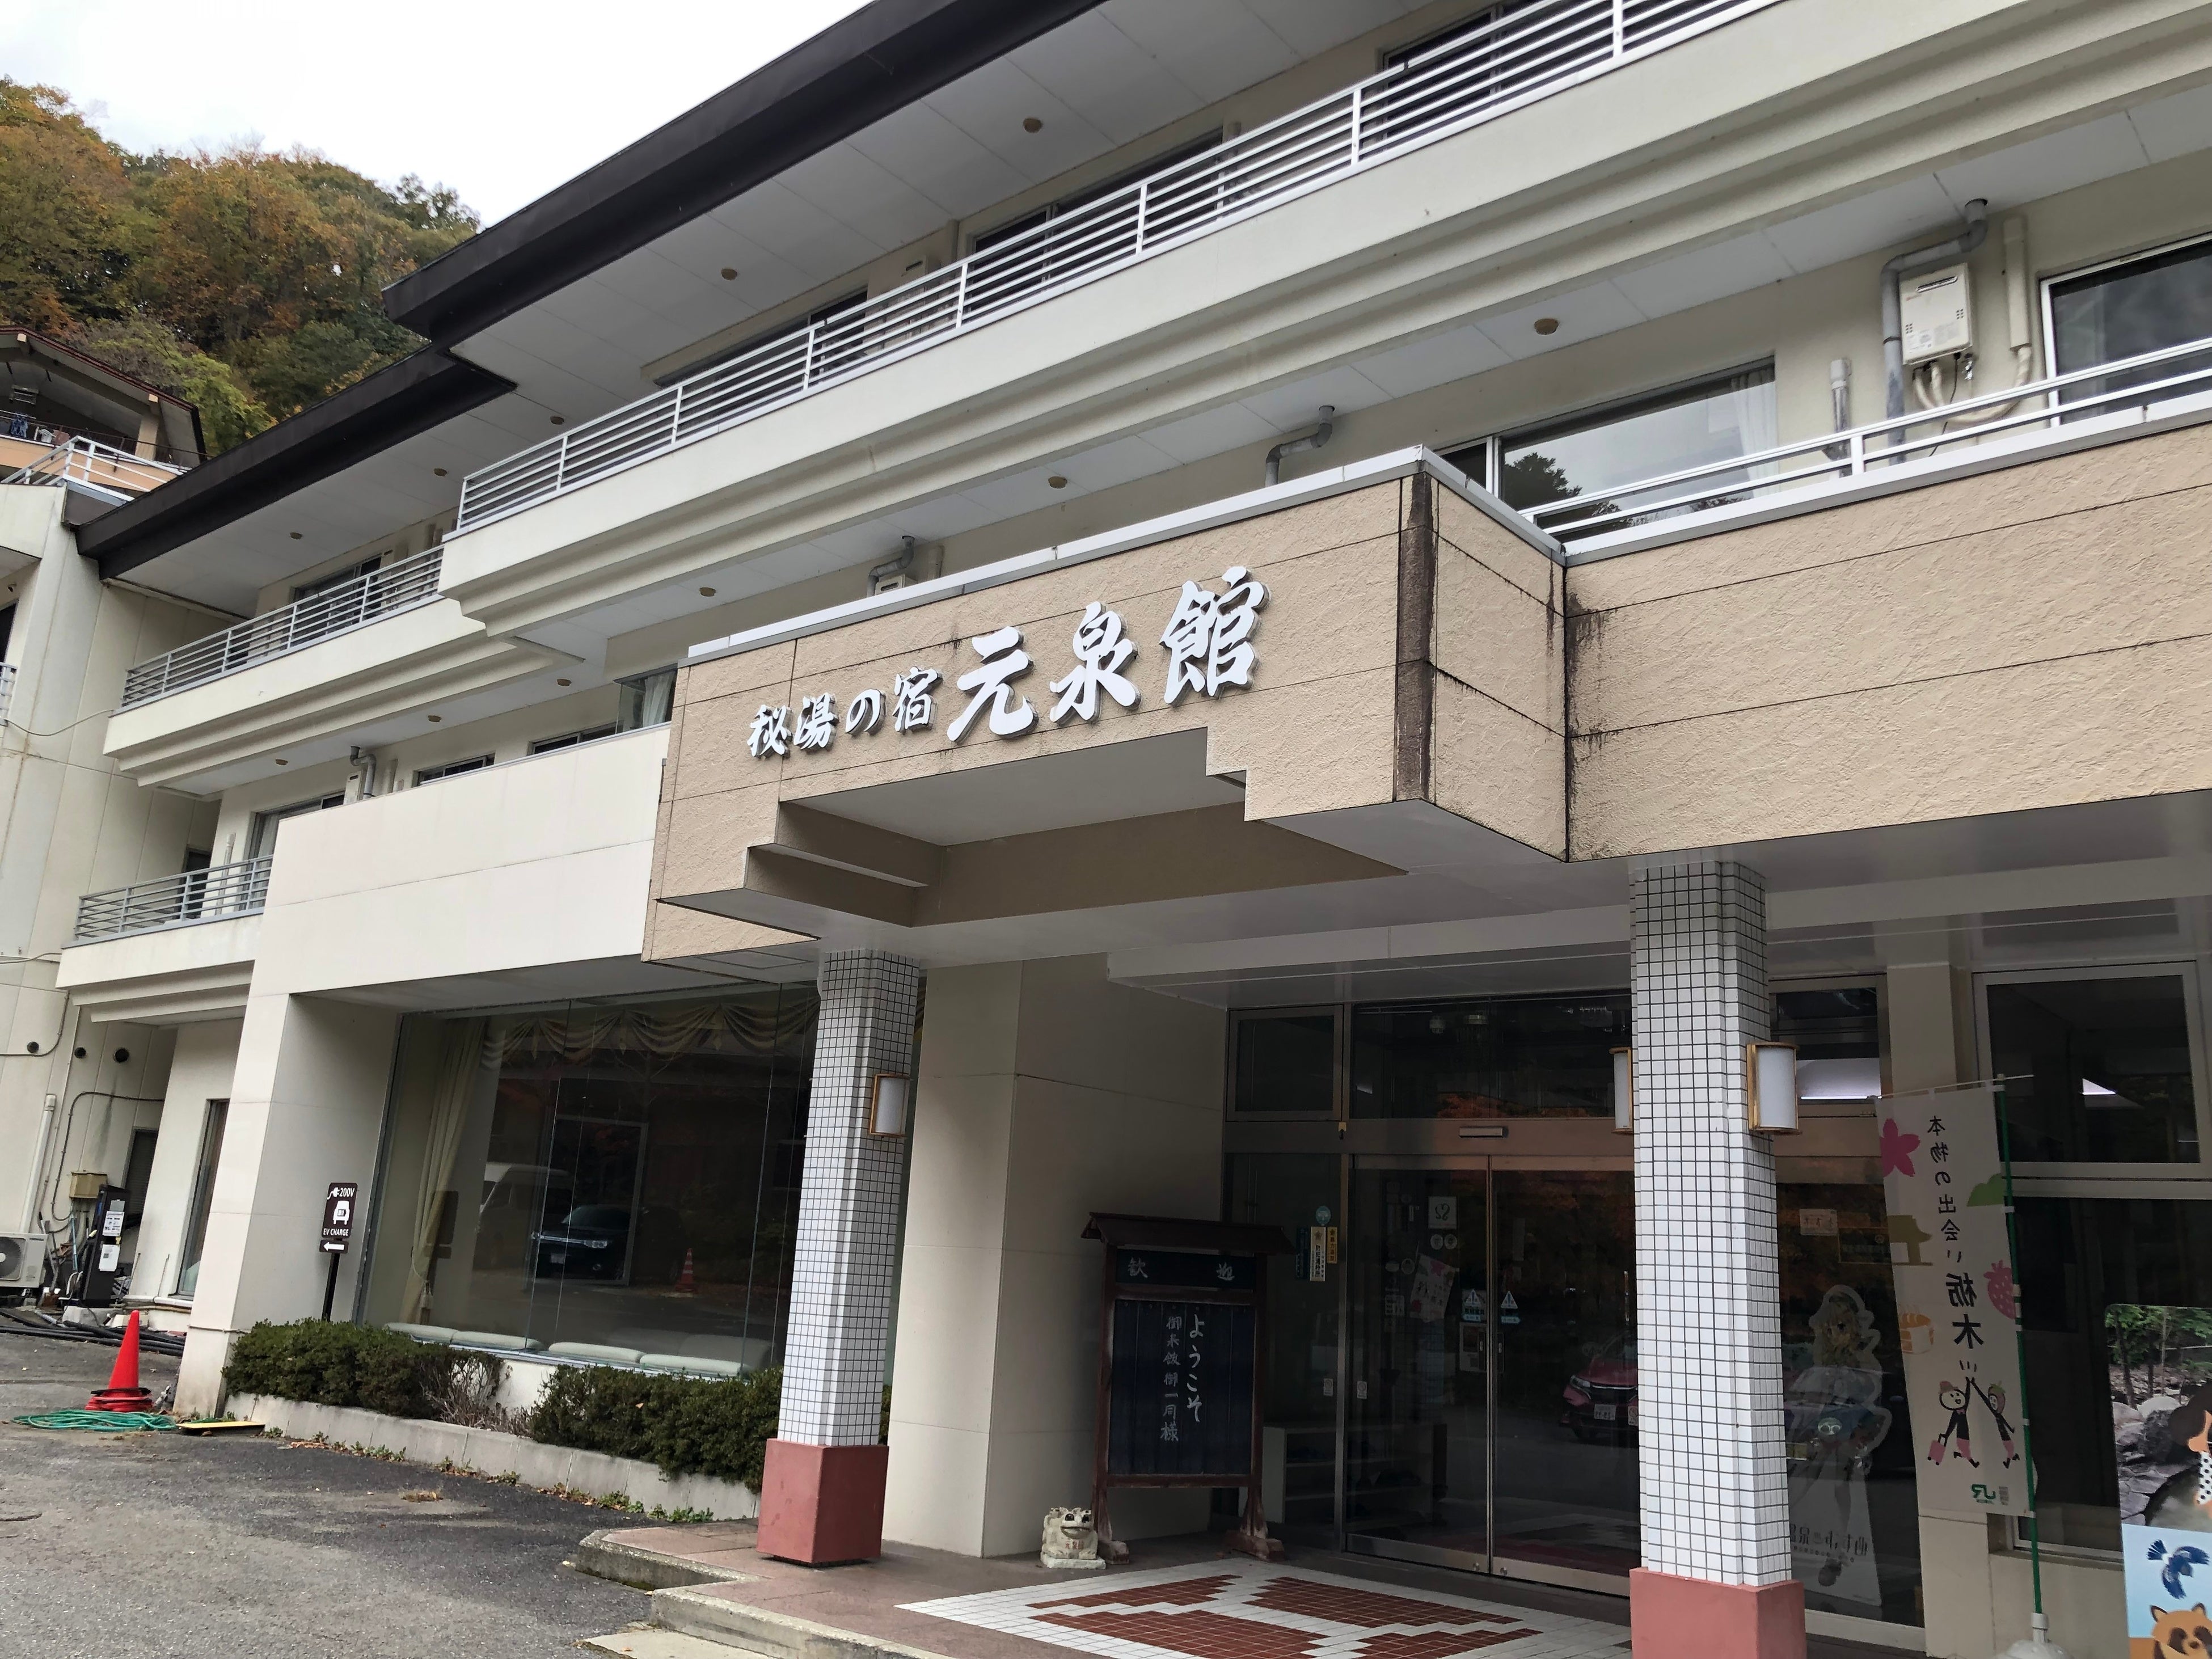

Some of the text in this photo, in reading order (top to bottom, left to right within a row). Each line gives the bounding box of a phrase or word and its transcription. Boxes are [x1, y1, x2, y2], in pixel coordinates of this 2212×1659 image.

[748, 567, 1269, 758] 秘湯の宿 元泉館
[339, 1187, 355, 1197] 200V
[330, 1228, 349, 1236] CHARGE
[1187, 1314, 1205, 1422] ようこそ
